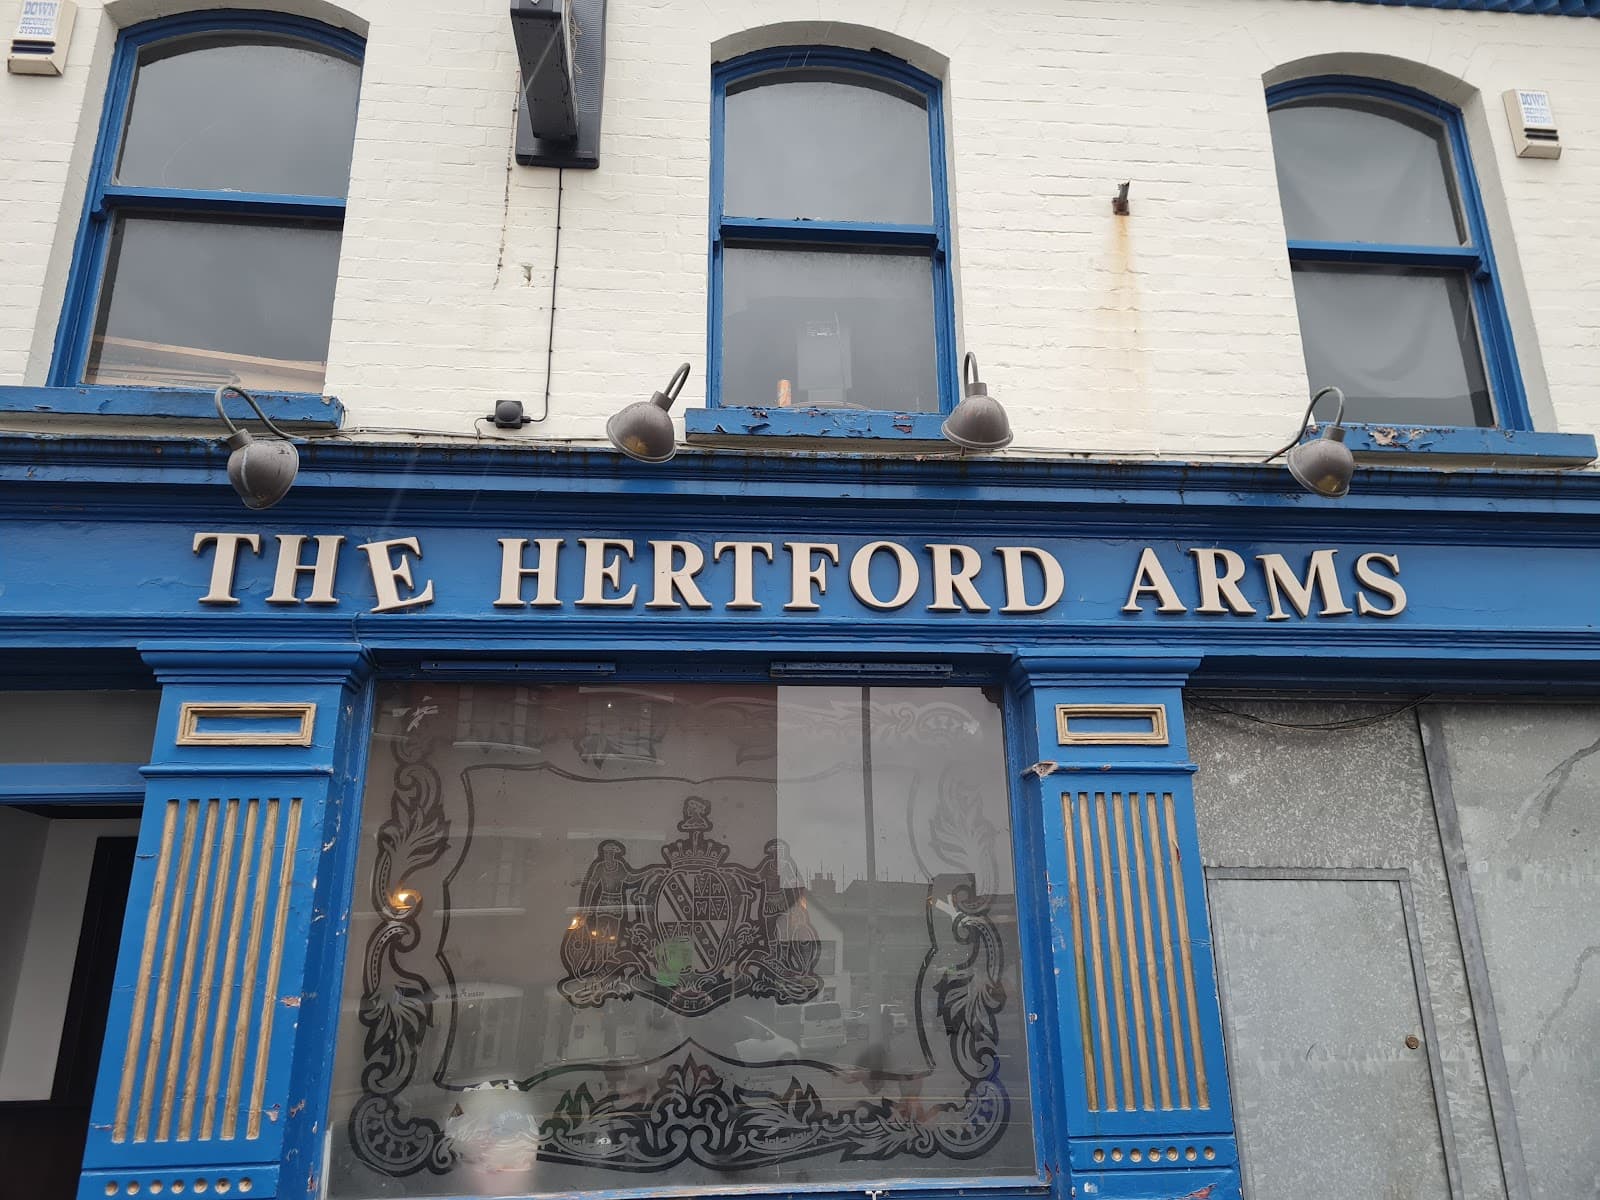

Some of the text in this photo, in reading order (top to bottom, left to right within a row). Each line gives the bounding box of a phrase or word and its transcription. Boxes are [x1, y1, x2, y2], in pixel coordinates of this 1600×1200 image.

[23, 1, 57, 17] DOWN
[192, 532, 1409, 622] THE HERTFORD ARMS
[683, 999, 698, 1009] ET
